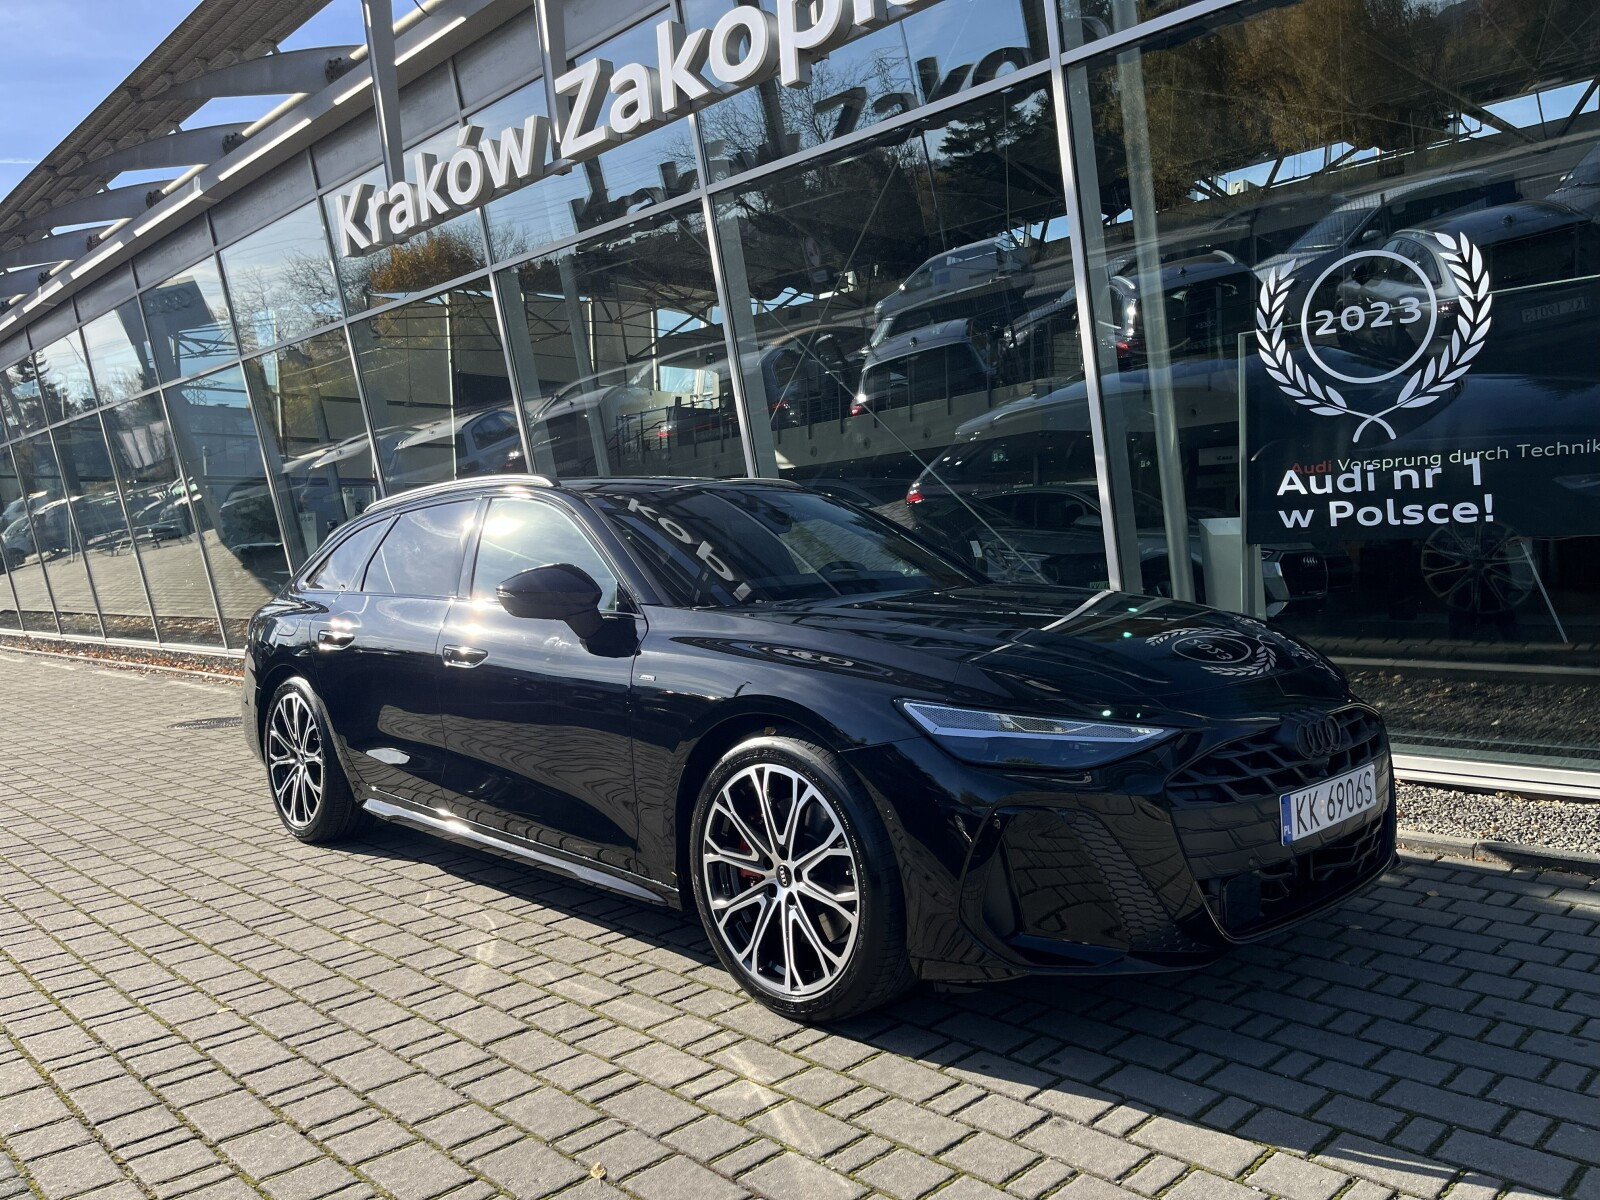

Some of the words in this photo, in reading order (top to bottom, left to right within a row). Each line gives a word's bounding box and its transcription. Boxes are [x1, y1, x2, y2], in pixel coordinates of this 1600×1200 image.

[337, 115, 551, 257] Kraków
[1314, 297, 1423, 336] 2023
[1276, 464, 1376, 496] Audi
[1393, 467, 1443, 490] nr
[1463, 456, 1482, 486] 1
[1292, 460, 1333, 475] Audi
[1337, 454, 1442, 472] Vorsprung
[1449, 446, 1509, 464] durch
[1516, 438, 1600, 458] Technik
[1278, 508, 1315, 529] w
[1328, 493, 1494, 528] Polsce!
[1295, 790, 1321, 835] KK
[1326, 770, 1373, 822] 6906S
[1283, 824, 1292, 836] PL
